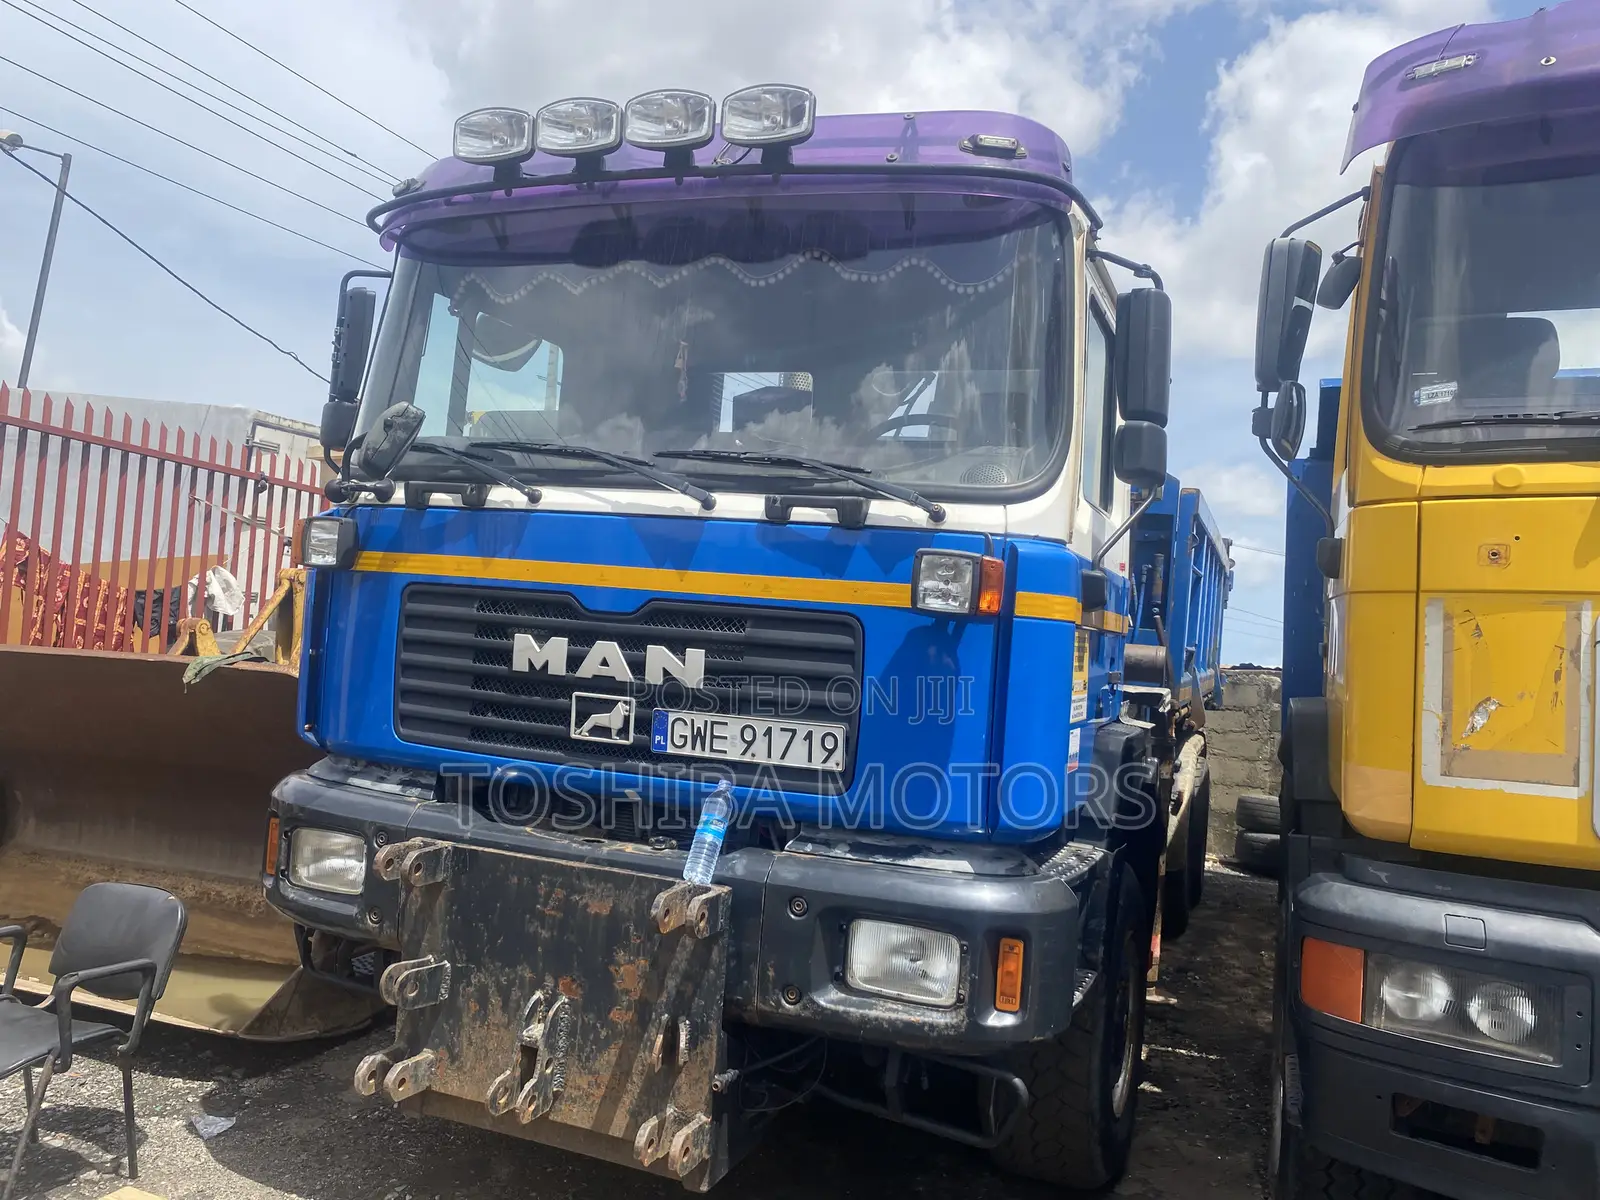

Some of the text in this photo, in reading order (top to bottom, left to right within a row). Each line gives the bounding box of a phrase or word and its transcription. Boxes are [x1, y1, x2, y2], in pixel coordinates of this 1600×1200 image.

[513, 633, 706, 689] MAN
[654, 735, 666, 745] PL
[670, 717, 839, 765] GWE 91719
